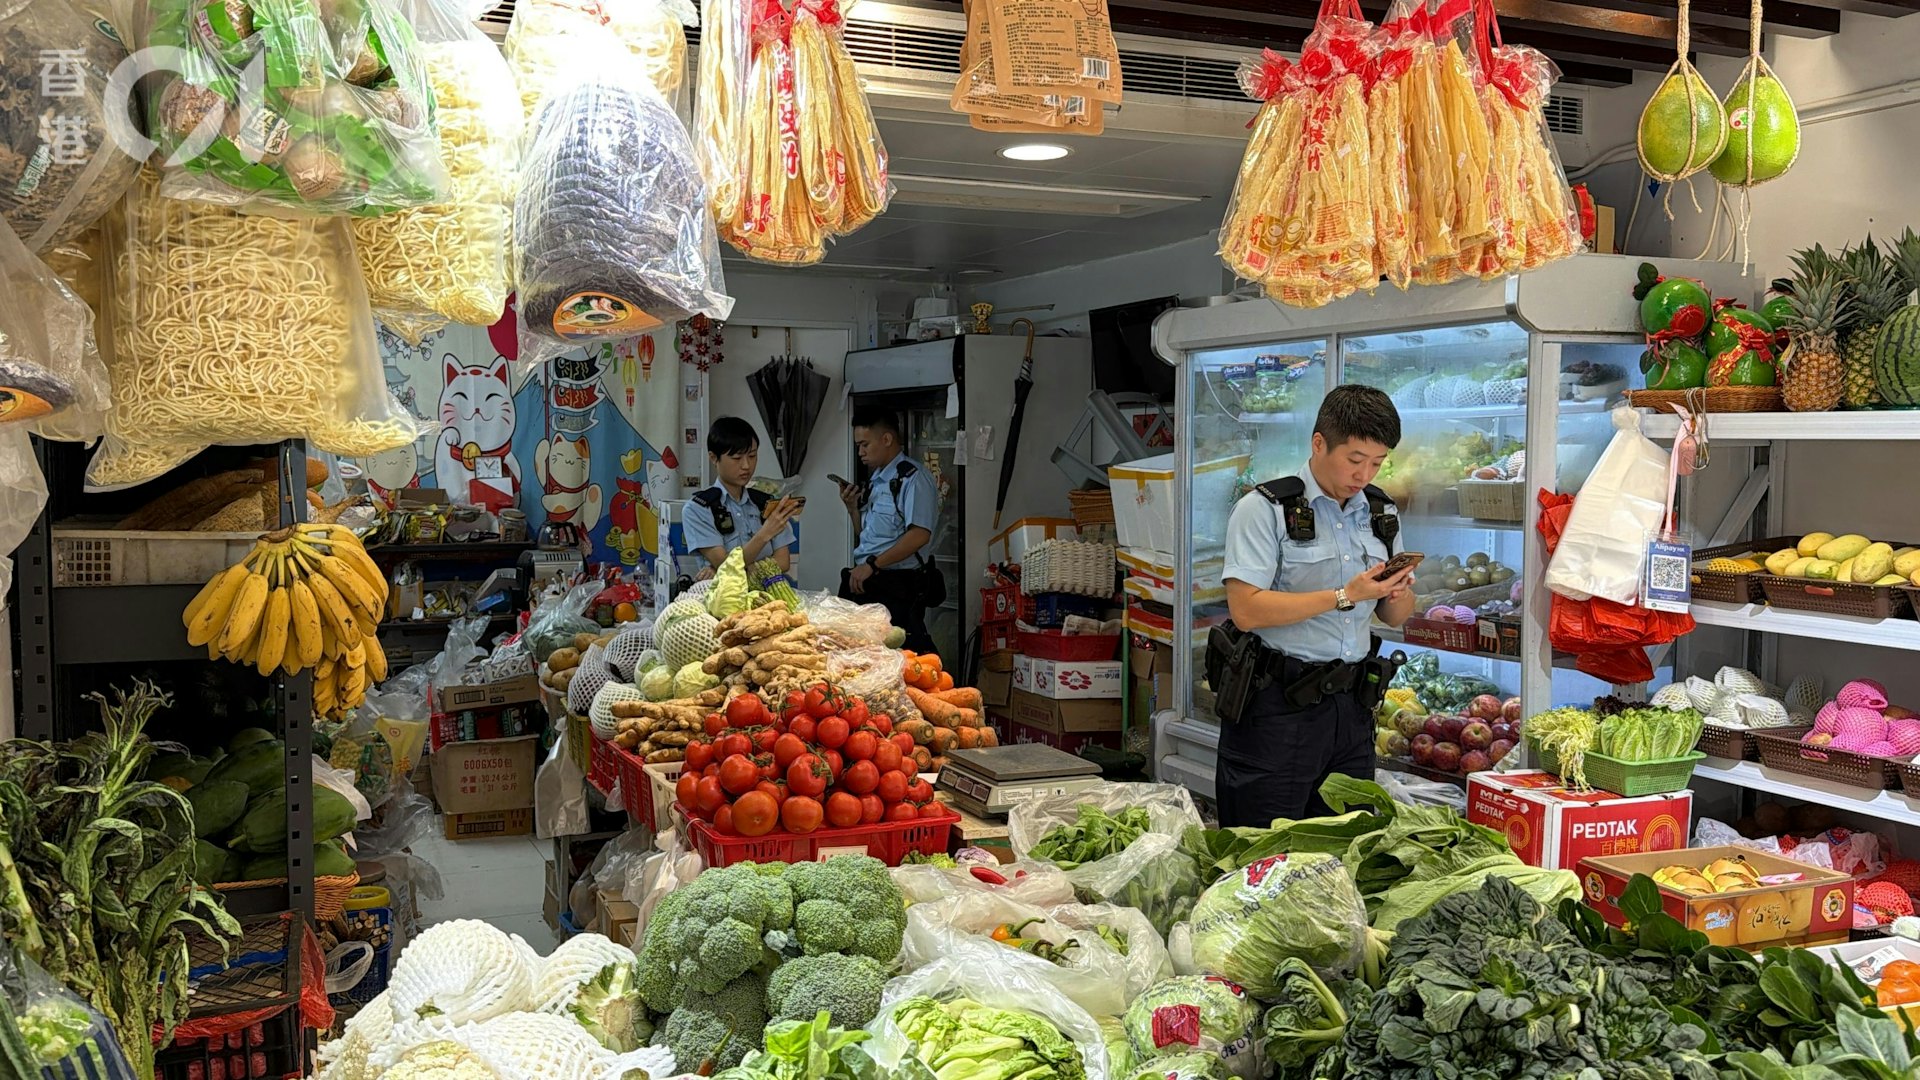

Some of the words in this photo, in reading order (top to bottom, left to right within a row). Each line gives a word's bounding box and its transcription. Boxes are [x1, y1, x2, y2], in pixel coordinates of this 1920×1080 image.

[1480, 789, 1518, 808] MFC
[1475, 801, 1505, 820] PEDTAK
[1572, 819, 1637, 839] PEDTAK
